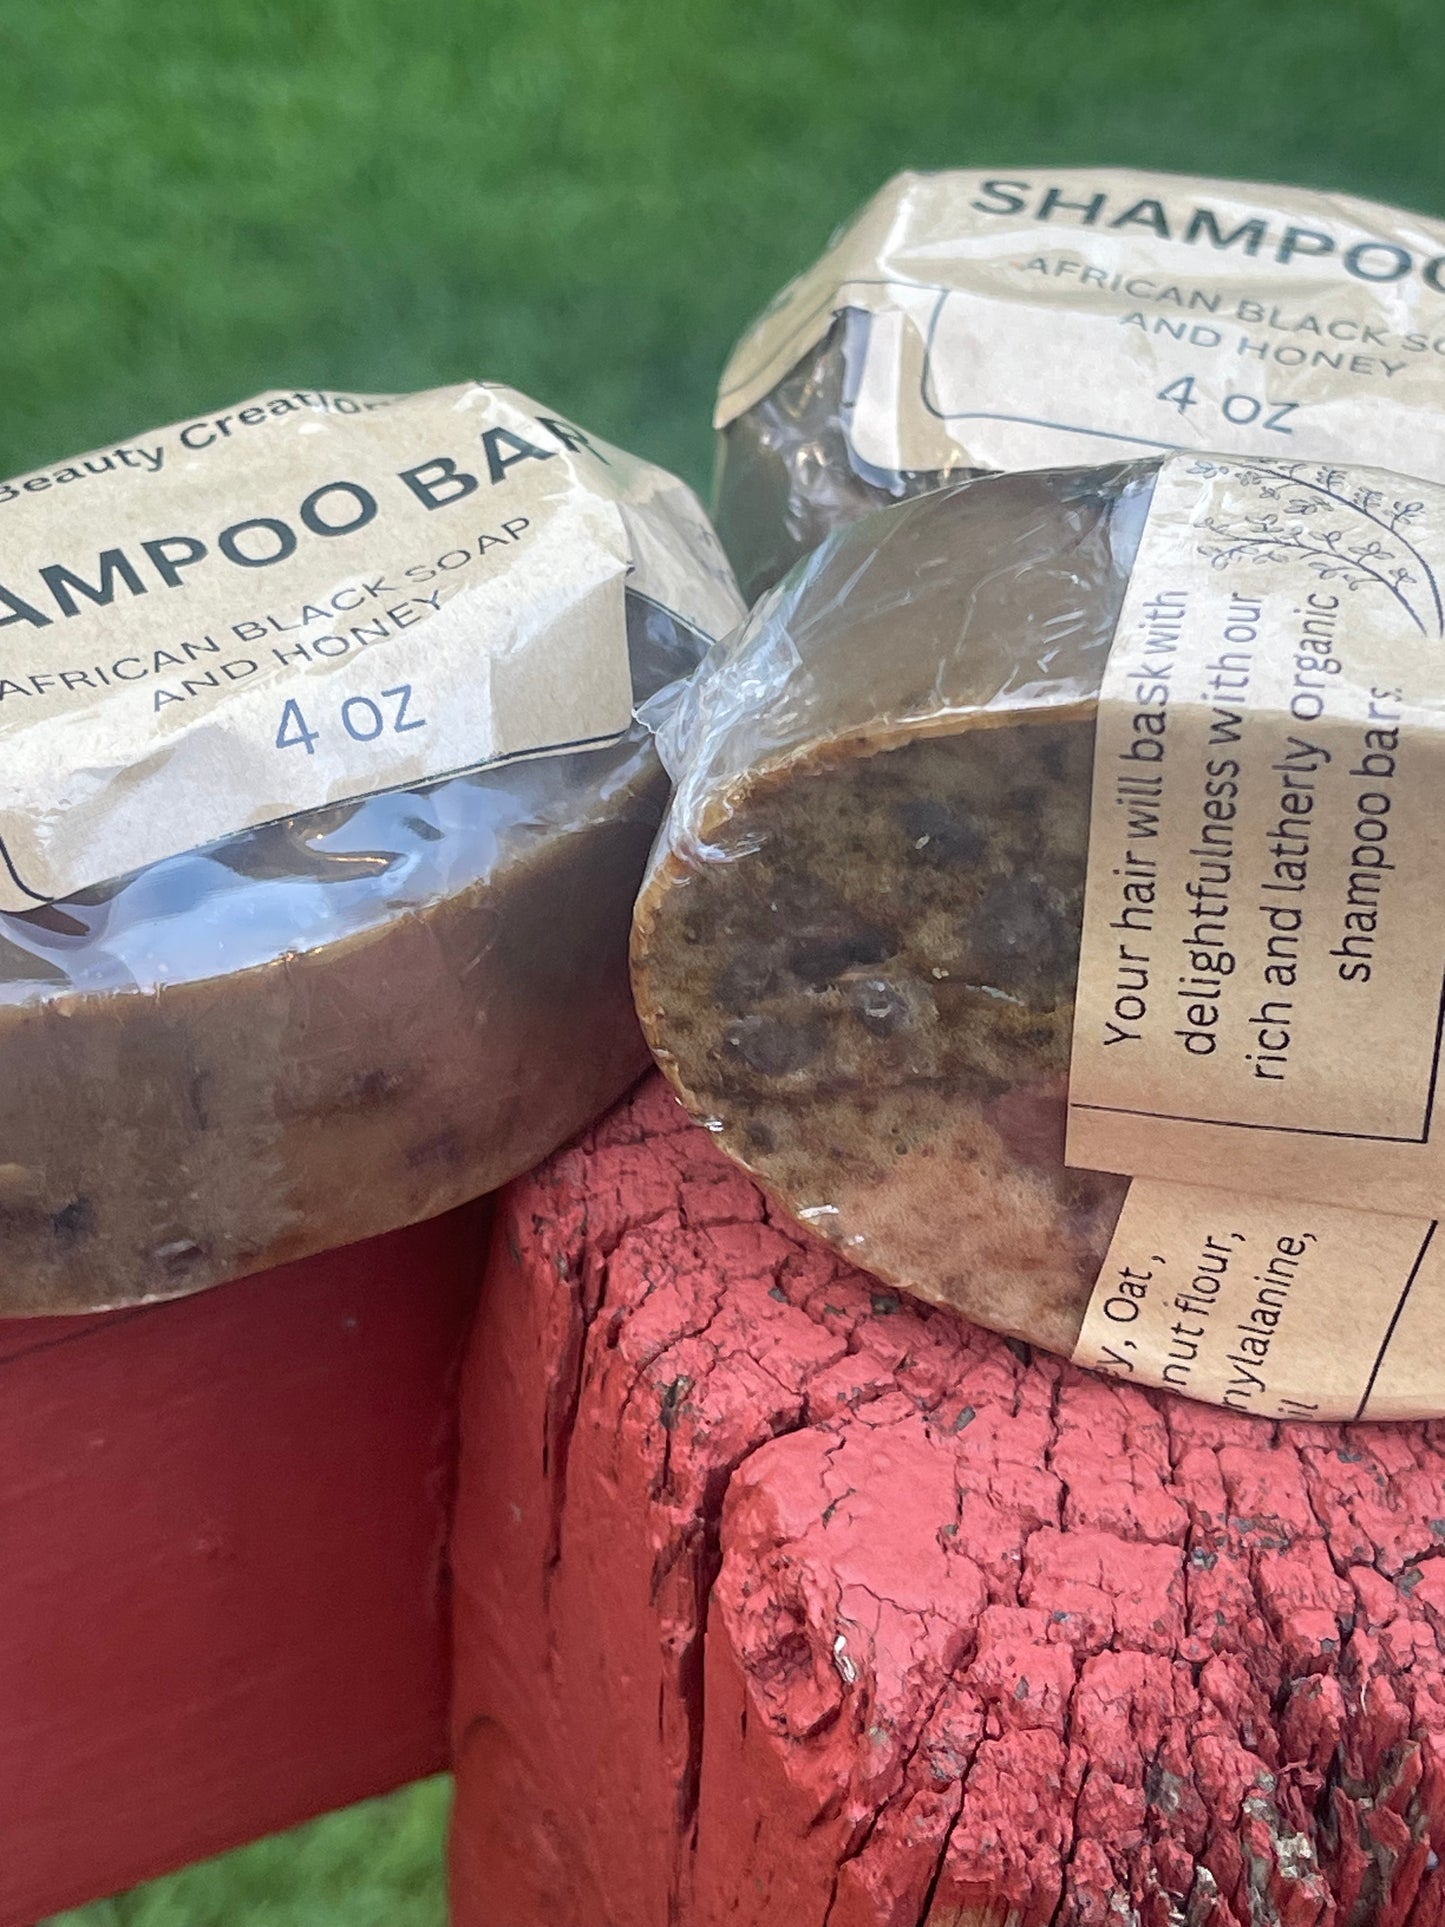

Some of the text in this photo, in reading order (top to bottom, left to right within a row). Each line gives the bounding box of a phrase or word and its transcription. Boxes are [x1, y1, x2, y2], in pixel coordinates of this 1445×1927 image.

[1023, 258, 1222, 314] AFRICAN
[1237, 299, 1393, 347] BLACK
[1120, 311, 1408, 378] AND HONEY
[398, 416, 610, 511] BAR
[1157, 375, 1302, 435] 4 OZ
[0, 516, 530, 700] AFRICAN BLACK SOAP
[153, 589, 443, 712] AND HONEY
[274, 684, 426, 755] 4 OZ
[1103, 590, 1189, 1046] Your hair will bask with
[1174, 591, 1263, 1055] delightfulness with our
[1245, 593, 1342, 1080] rich and latherly organic
[1329, 792, 1395, 983] shampoo
[1162, 1232, 1246, 1388] nut flour,
[1221, 1232, 1318, 1409] nylalanine,
